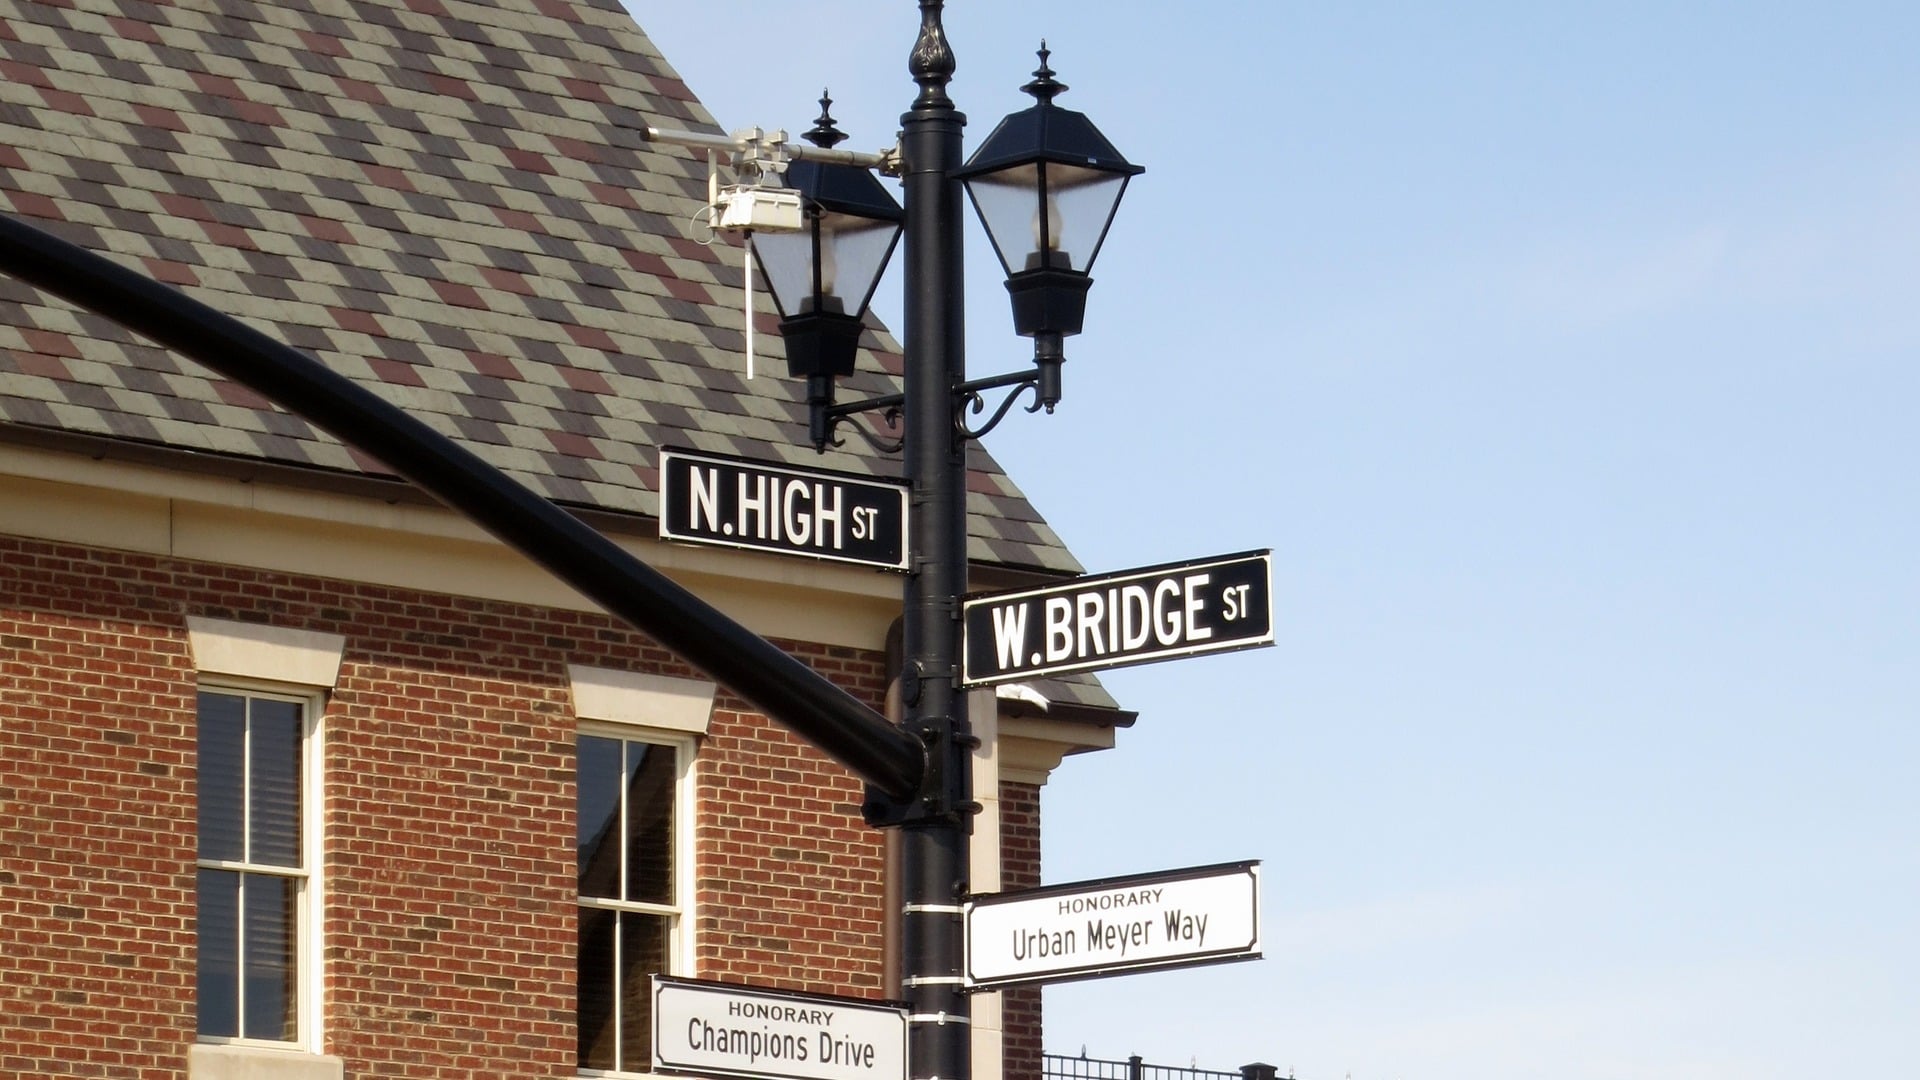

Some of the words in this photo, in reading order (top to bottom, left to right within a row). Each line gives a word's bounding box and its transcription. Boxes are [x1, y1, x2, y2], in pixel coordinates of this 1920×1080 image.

[851, 505, 879, 541] ST
[1221, 584, 1250, 621] ST
[1058, 888, 1164, 915] HONORARY
[1012, 928, 1076, 961] Urban
[1087, 918, 1153, 957] Meyer
[1163, 908, 1208, 948] Way
[728, 1001, 835, 1027] HONORARY
[687, 1017, 808, 1065] Champions
[819, 1031, 875, 1069] Drive
